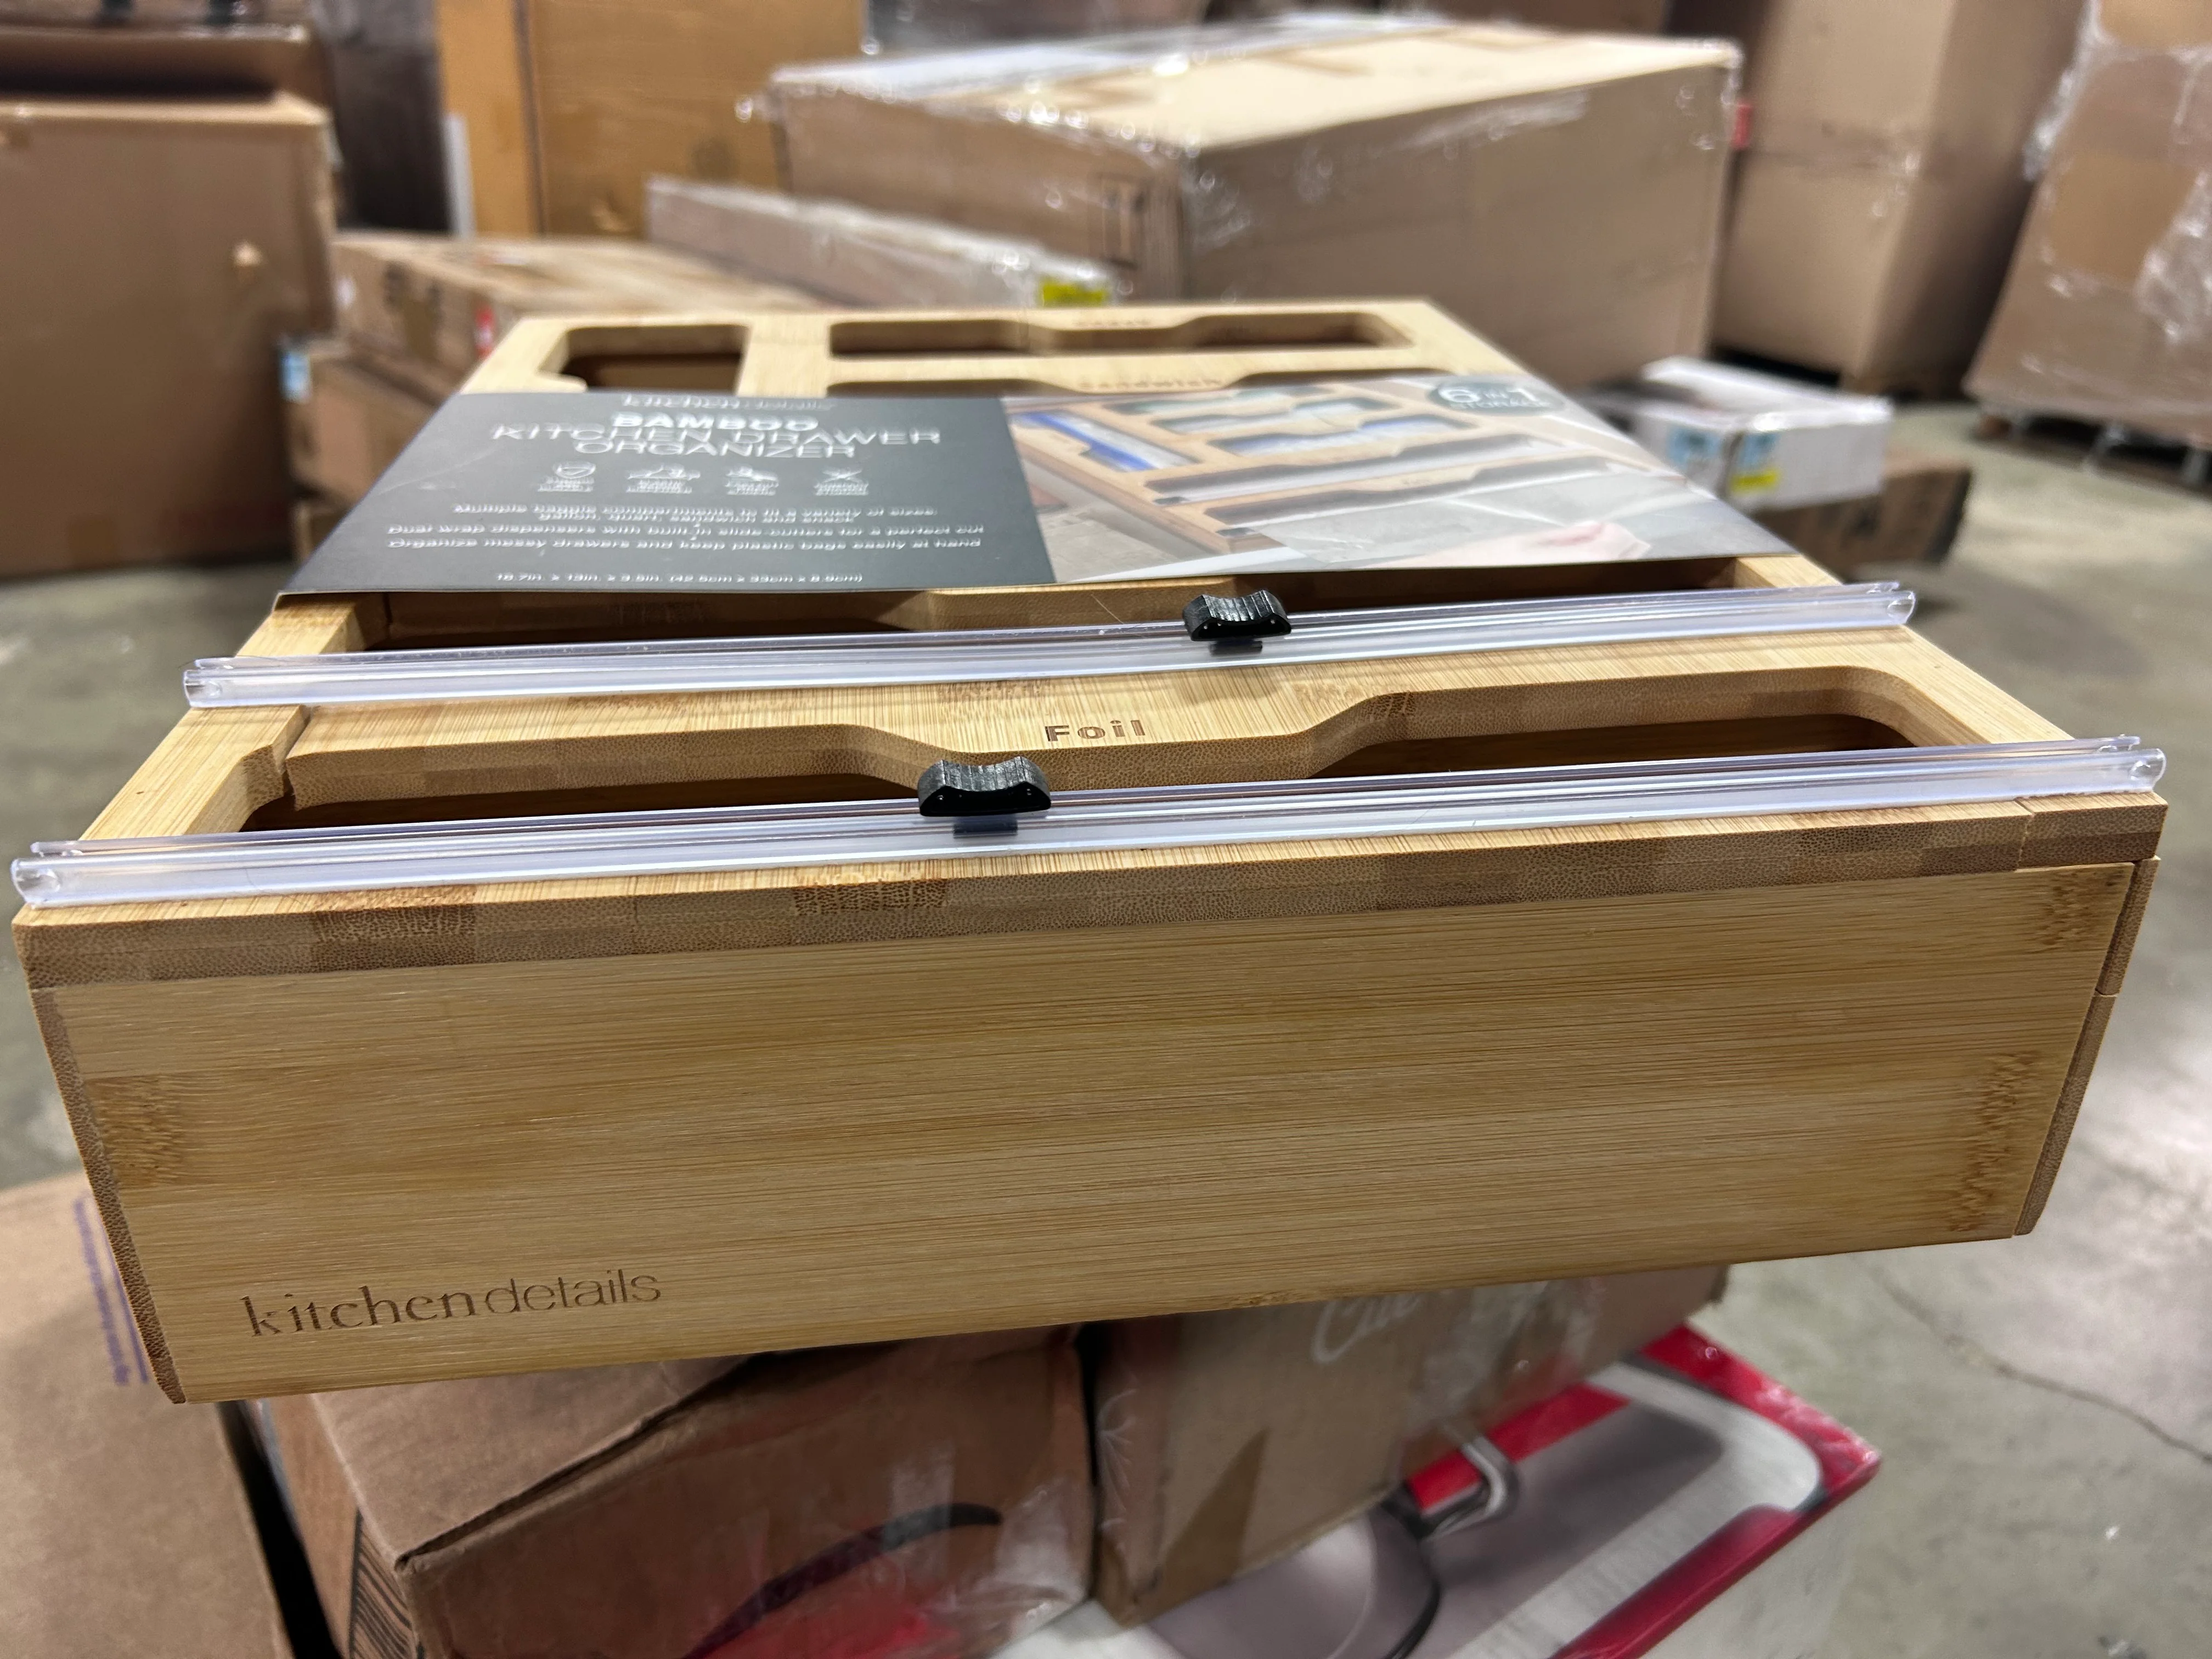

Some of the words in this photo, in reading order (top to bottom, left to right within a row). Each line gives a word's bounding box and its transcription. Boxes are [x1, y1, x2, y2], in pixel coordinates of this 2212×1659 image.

[1438, 387, 1481, 403] 6
[1507, 387, 1538, 402] 1
[611, 412, 819, 430] BAMBOO
[493, 423, 712, 442] KITCHEN
[733, 427, 940, 445] DRAWER
[575, 439, 855, 458] ORGANIZER
[454, 504, 527, 514] Multiple
[602, 505, 733, 516] compartments
[739, 507, 757, 516] to
[763, 507, 779, 516] fit
[802, 507, 861, 517] variety
[866, 506, 884, 516] of
[669, 515, 755, 523] sandwich
[388, 524, 432, 534] Dual
[438, 525, 486, 534] wrap
[490, 524, 595, 534] dispensers
[601, 525, 640, 534] with
[718, 527, 761, 536] slide
[769, 526, 833, 536] cutters
[838, 526, 864, 536] for
[886, 525, 950, 536] perfect
[955, 524, 984, 534] cut
[388, 538, 477, 549] Organize
[483, 539, 547, 548] messy
[552, 539, 629, 548] drawers
[636, 539, 673, 549] and
[679, 540, 725, 550] keep
[731, 540, 794, 550] plastic
[800, 540, 846, 550] bags
[852, 539, 906, 550] easily
[911, 539, 929, 549] at
[934, 538, 981, 548] hand
[736, 574, 745, 583] x
[798, 574, 805, 582] x
[1045, 720, 1146, 742] Foil
